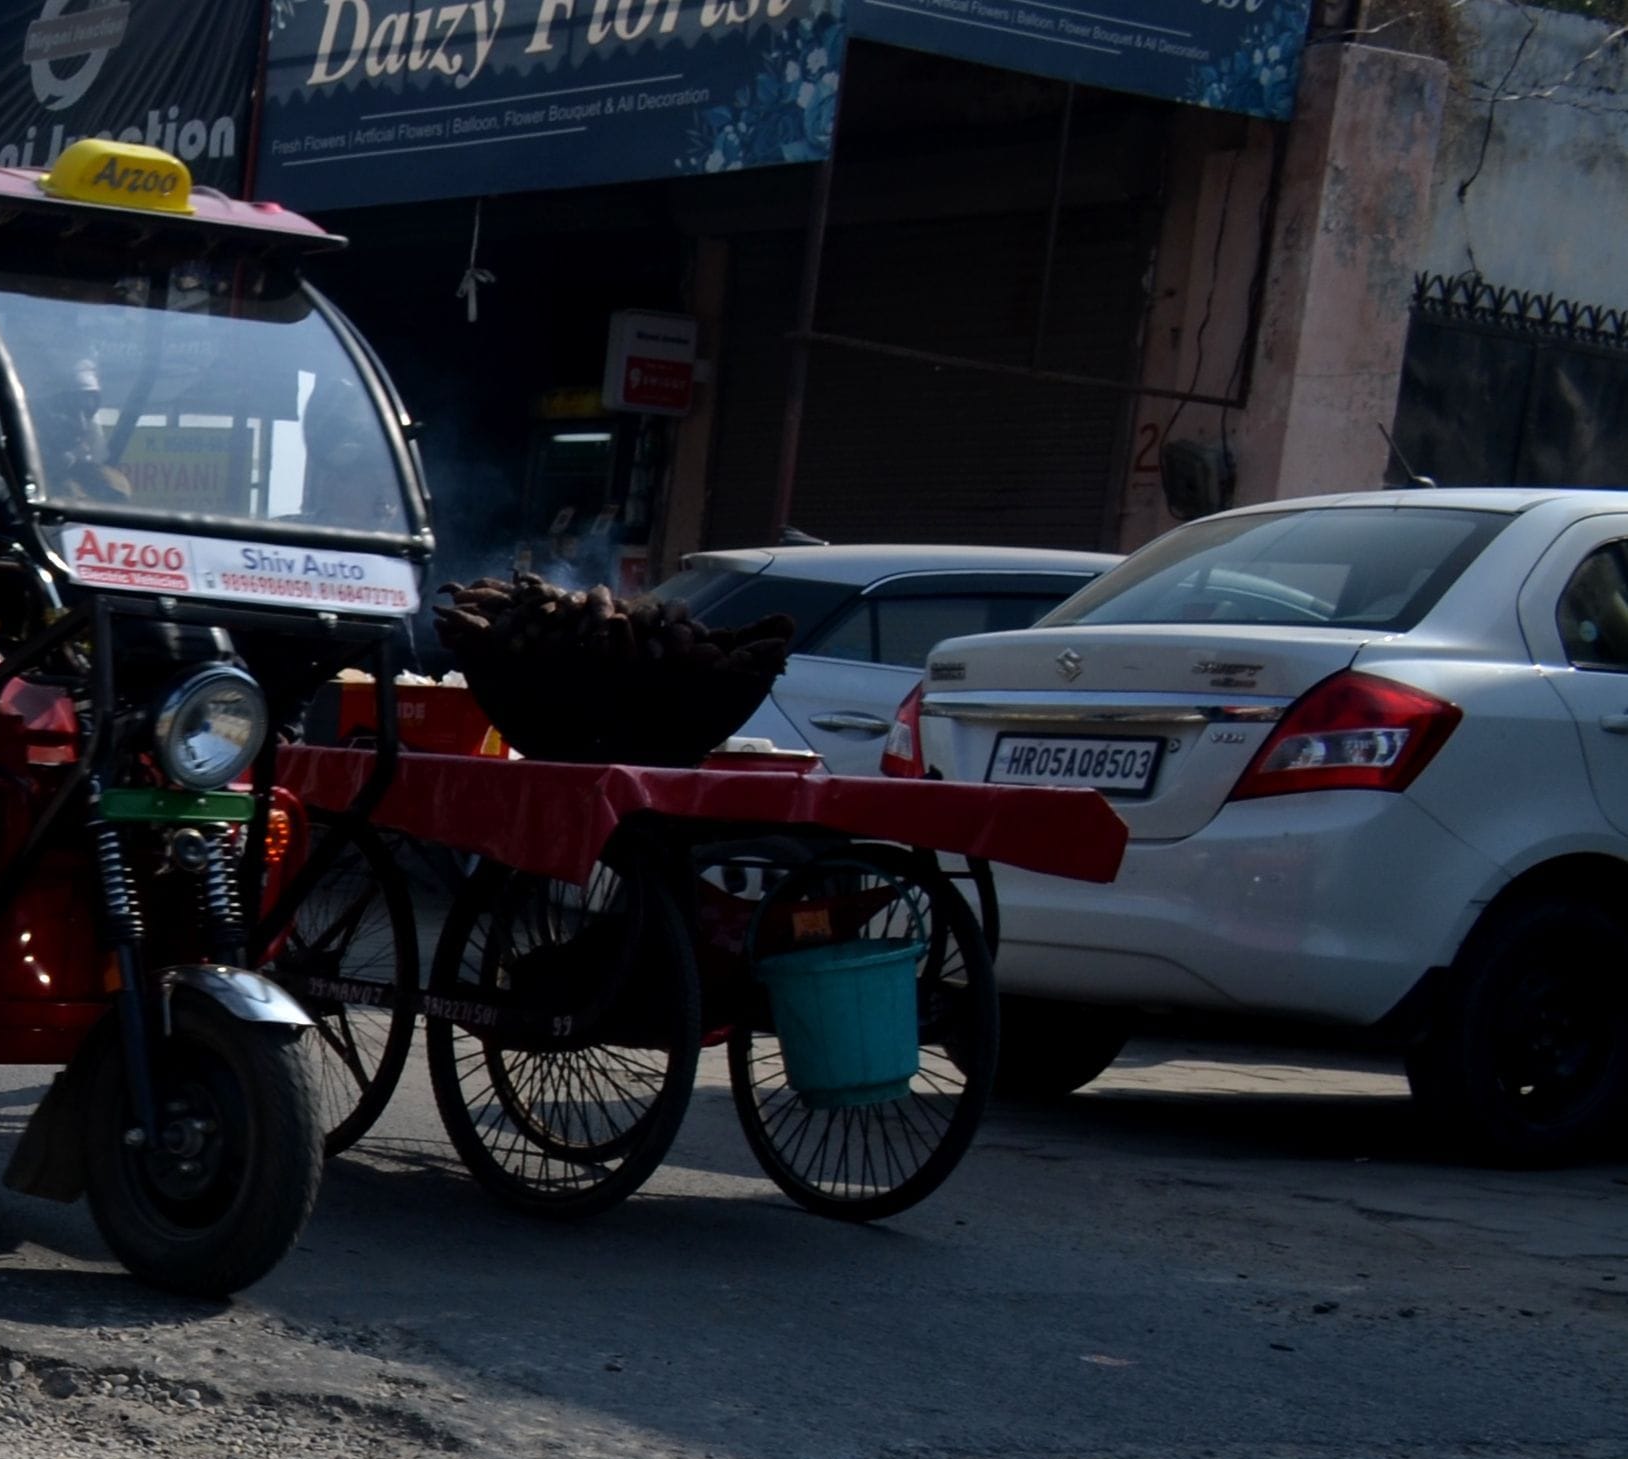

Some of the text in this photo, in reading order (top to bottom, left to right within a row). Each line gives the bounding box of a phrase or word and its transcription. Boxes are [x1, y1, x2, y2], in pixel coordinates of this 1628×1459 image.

[524, 0, 794, 54] Flor
[504, 109, 547, 128] Flower
[548, 102, 601, 122] Bouquet
[616, 95, 634, 112] All
[637, 87, 710, 110] Decoration
[44, 105, 235, 167] Jtion
[304, 133, 346, 152] Flowers
[398, 121, 442, 140] Flowers
[92, 156, 177, 193] Arzoo
[75, 530, 184, 571] Arzoo
[242, 547, 364, 580] Shiv Auto
[1006, 745, 1152, 779] HR05AQ8503
